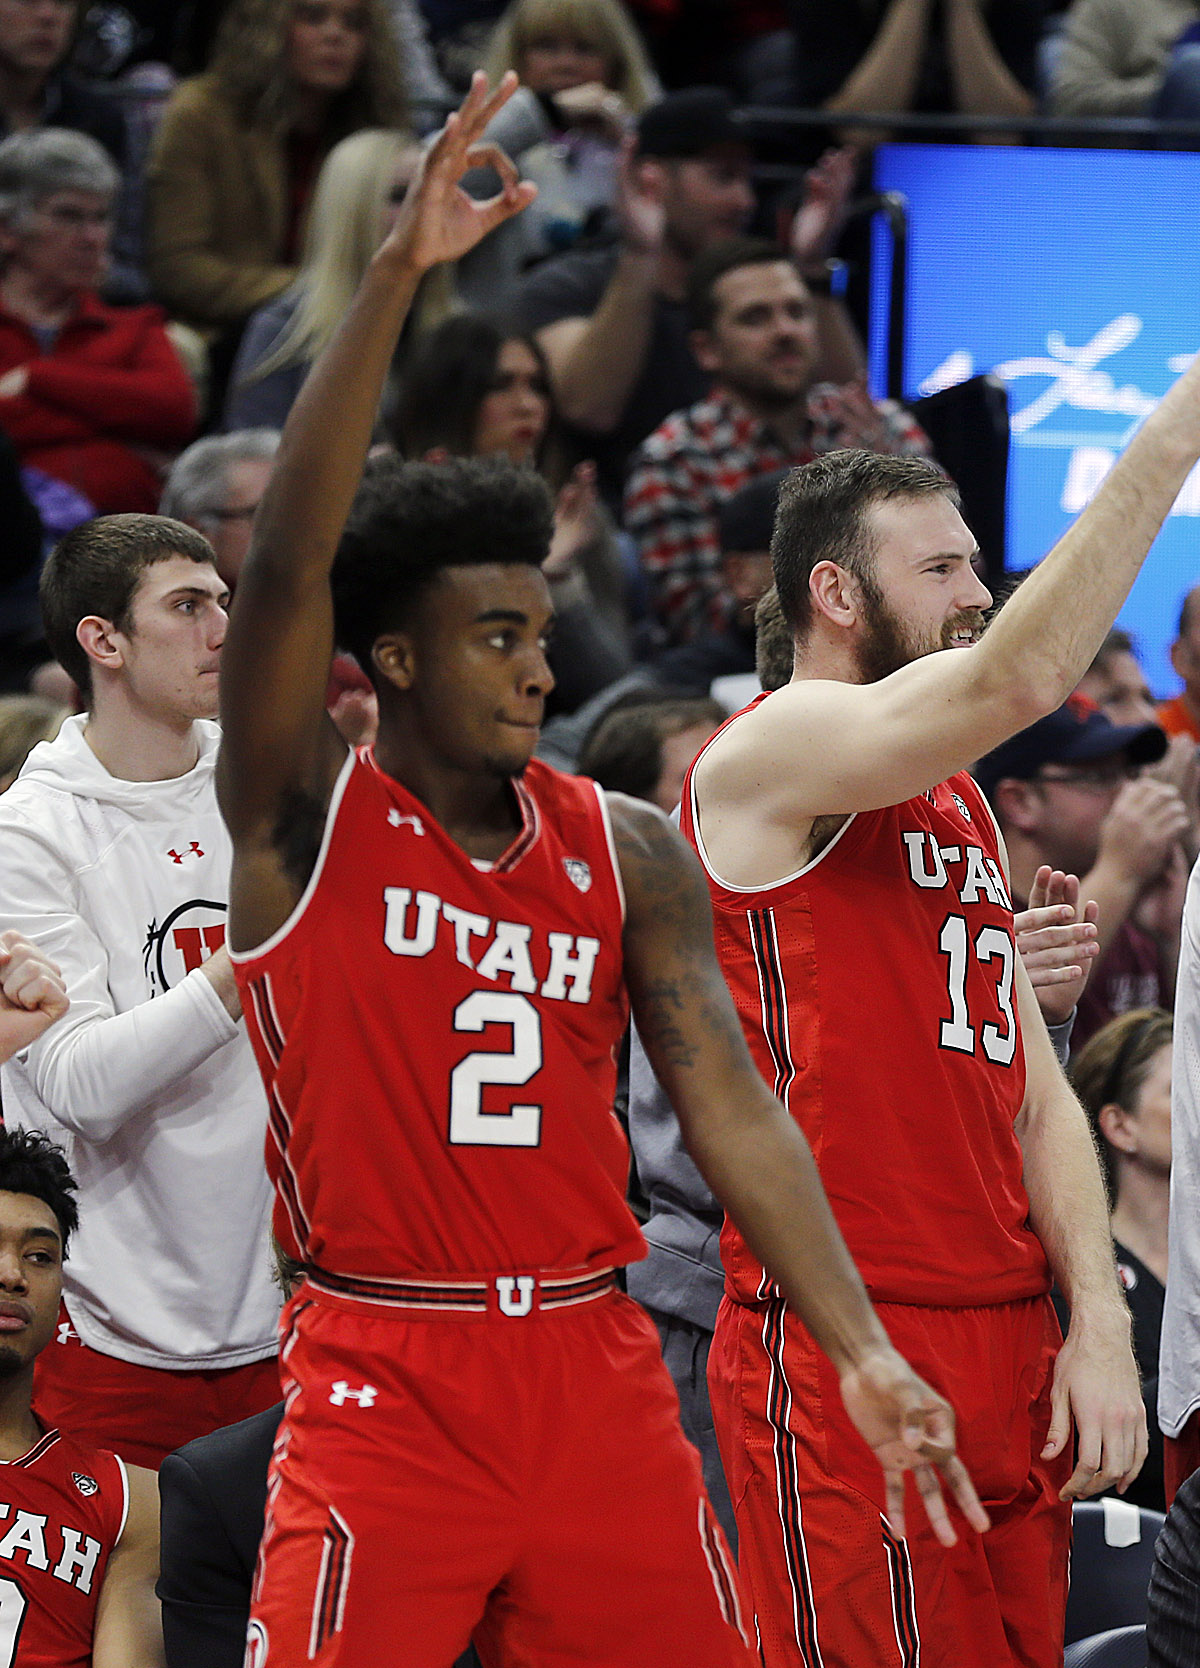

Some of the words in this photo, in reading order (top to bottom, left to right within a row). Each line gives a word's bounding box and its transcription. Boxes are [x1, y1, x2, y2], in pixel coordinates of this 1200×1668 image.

[904, 832, 1013, 912] UTAH
[383, 886, 601, 1005] UTAH
[938, 912, 1016, 1068] 13
[449, 989, 543, 1147] 2
[494, 1275, 536, 1318] U
